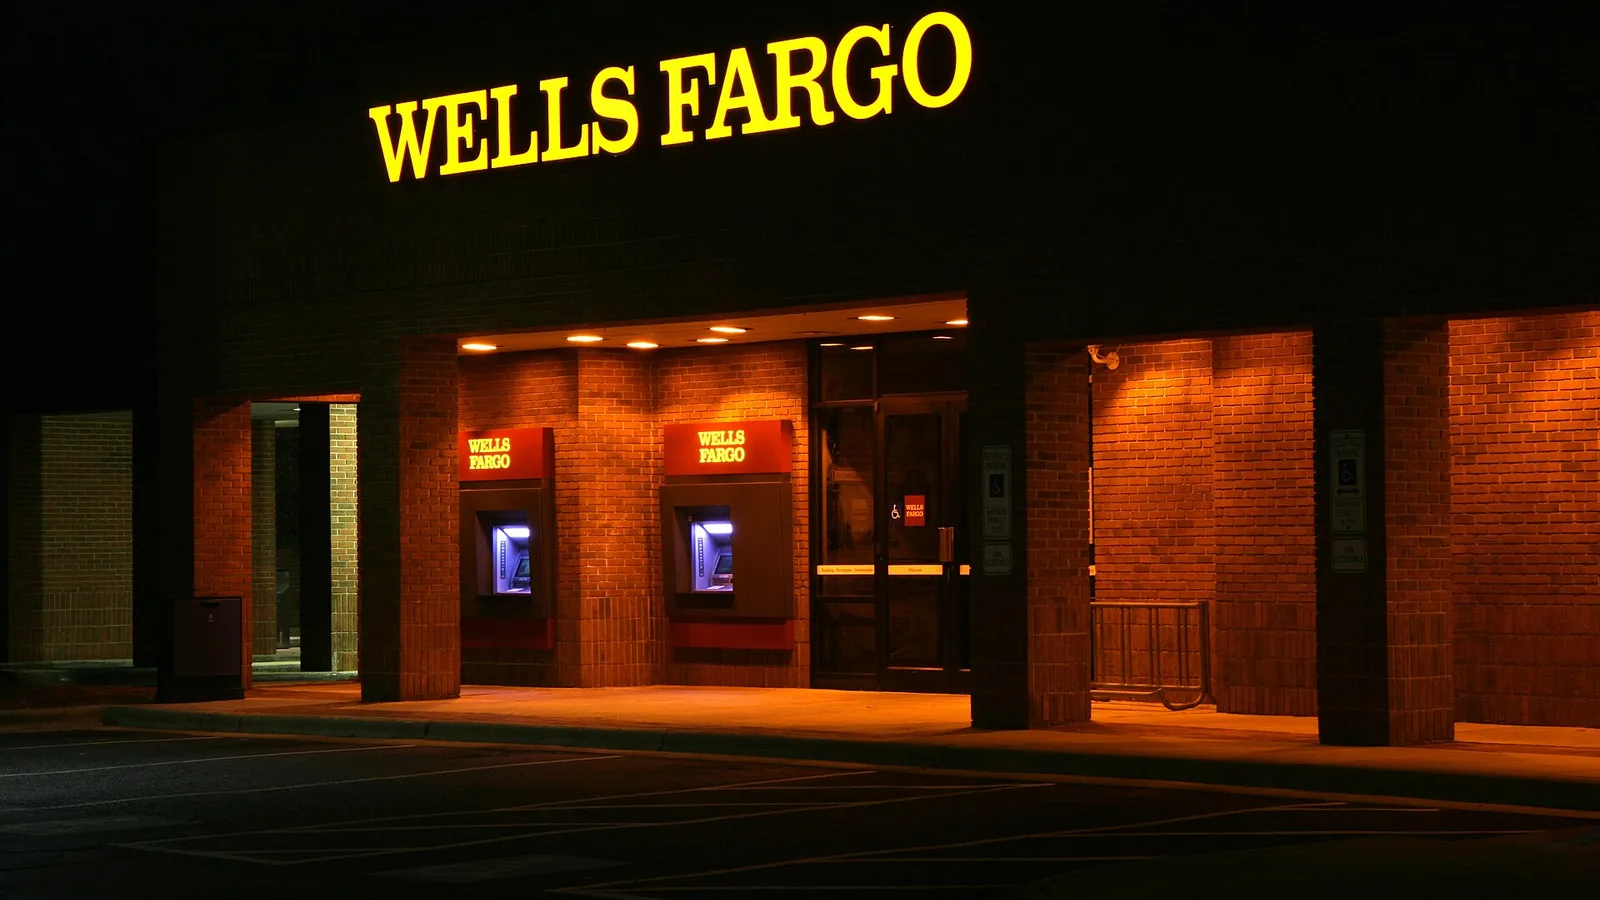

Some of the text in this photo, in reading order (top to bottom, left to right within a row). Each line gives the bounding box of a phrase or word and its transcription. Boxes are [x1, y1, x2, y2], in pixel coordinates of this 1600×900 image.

[368, 11, 973, 183] WELLS FARGO
[467, 437, 511, 453] WELLS
[697, 429, 746, 447] WELLS
[468, 453, 511, 469] FARGO
[698, 446, 746, 463] FARGO
